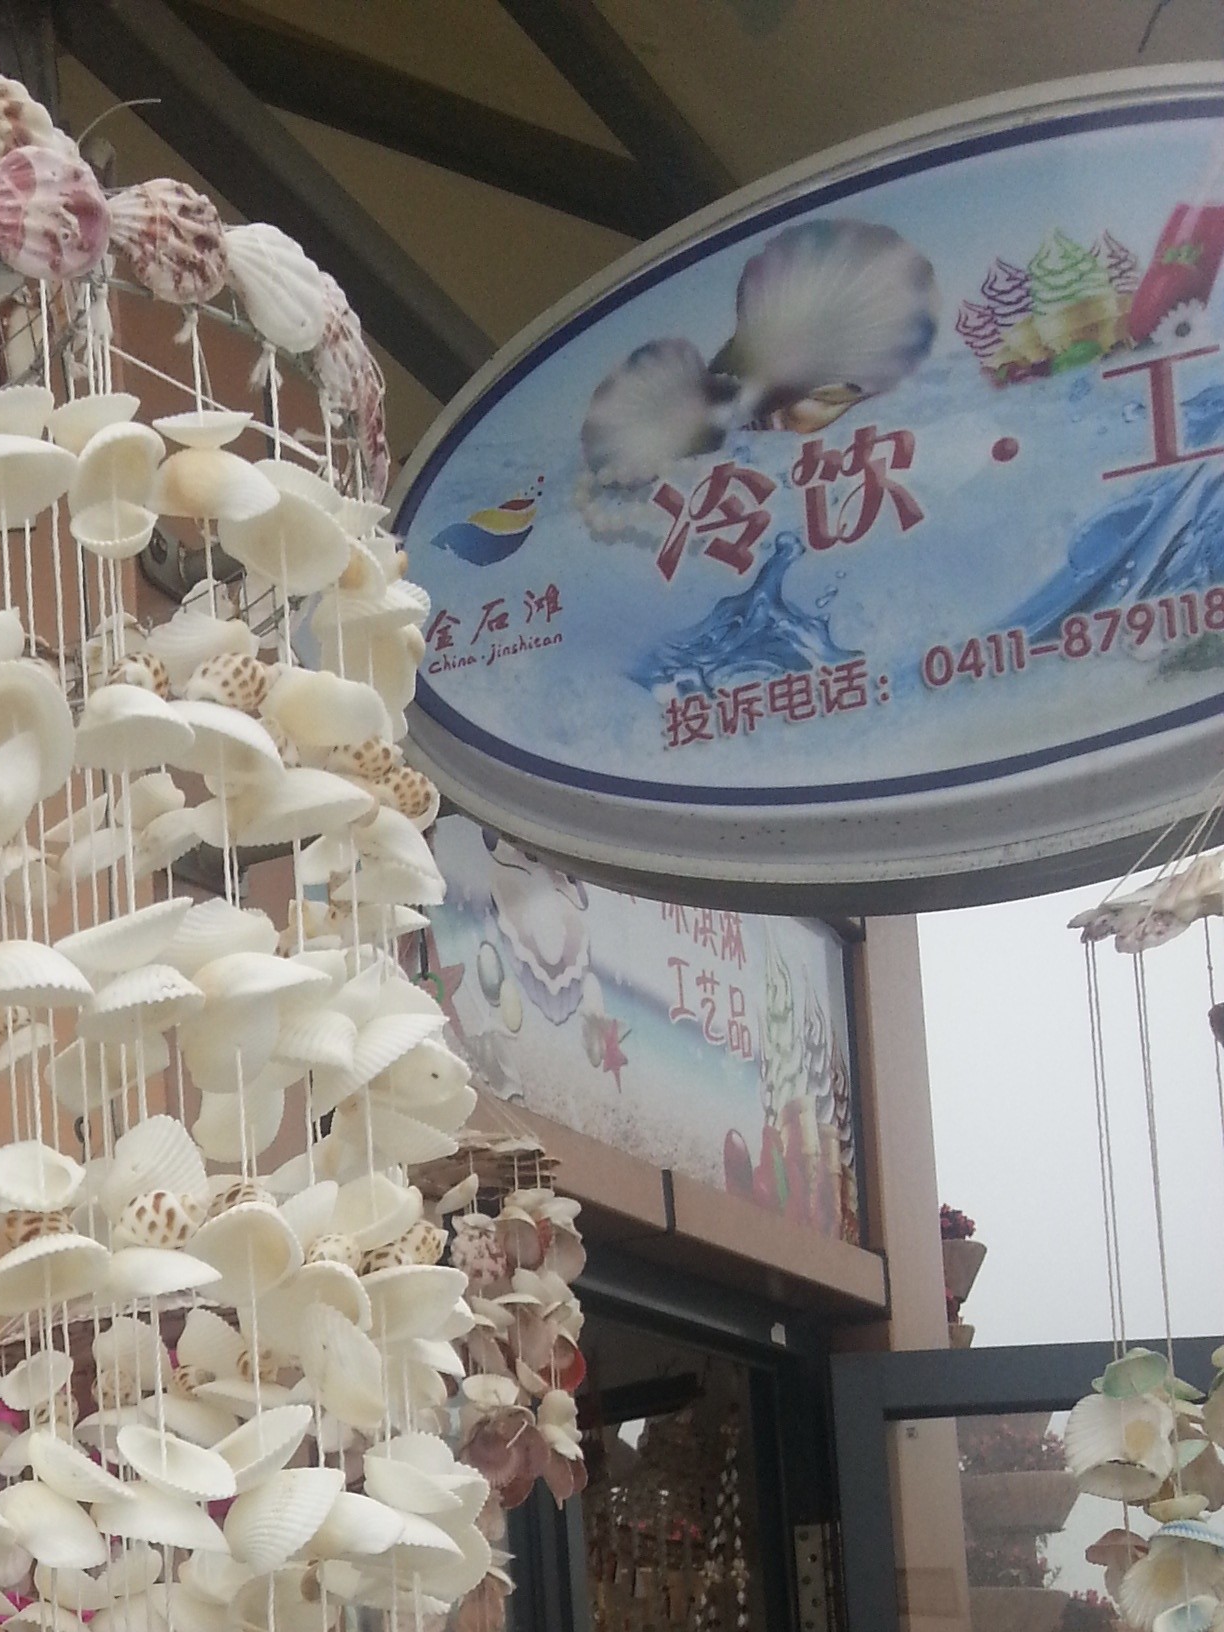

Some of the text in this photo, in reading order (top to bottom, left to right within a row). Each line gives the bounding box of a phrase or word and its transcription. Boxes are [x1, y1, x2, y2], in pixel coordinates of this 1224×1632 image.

[426, 583, 563, 651] 金石滩
[667, 957, 752, 1058] 工艺品
